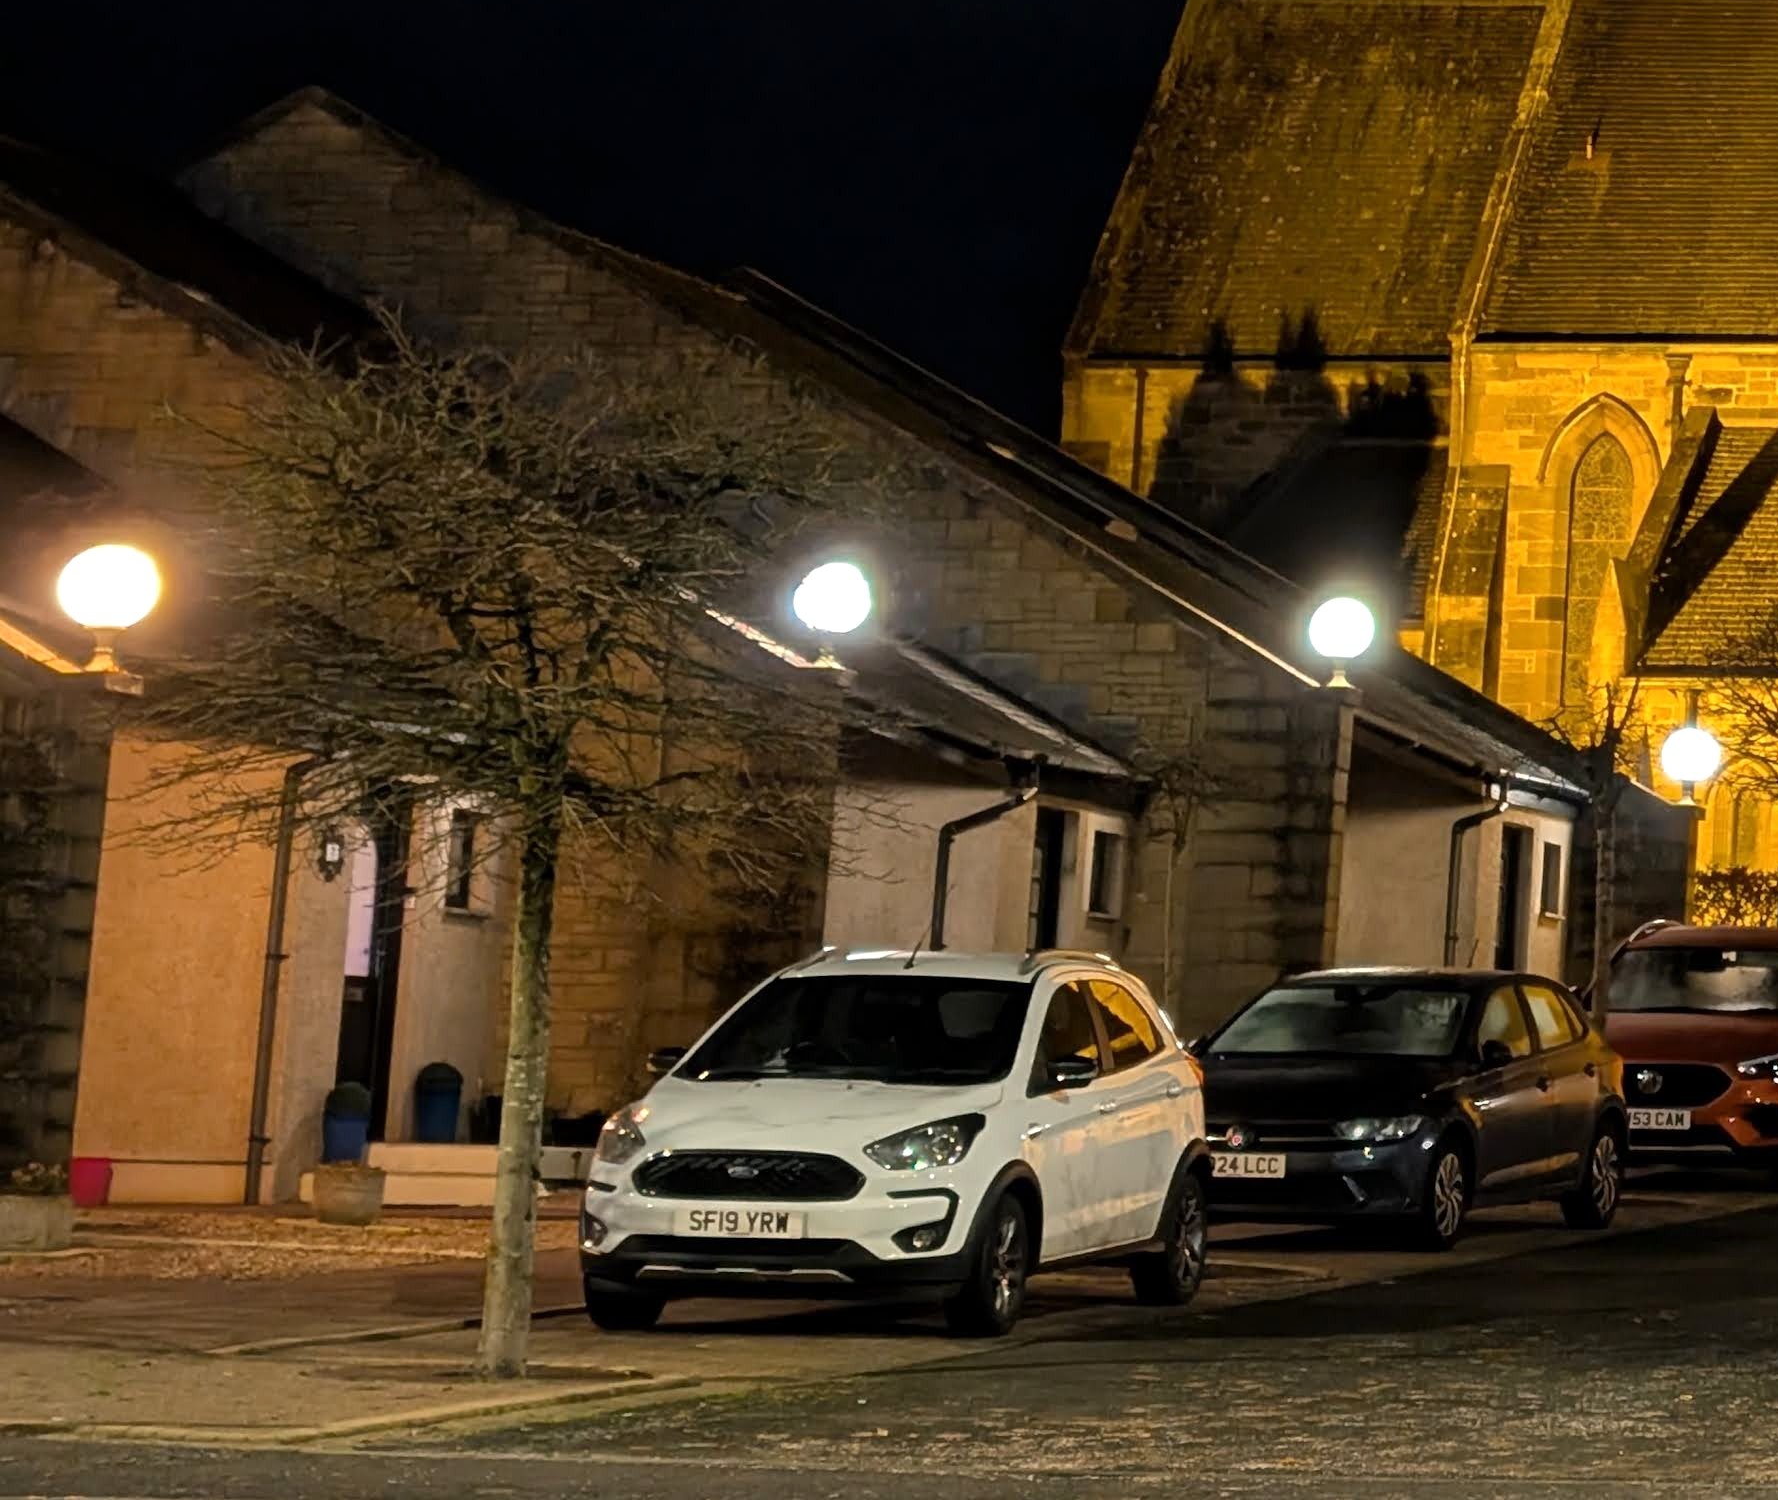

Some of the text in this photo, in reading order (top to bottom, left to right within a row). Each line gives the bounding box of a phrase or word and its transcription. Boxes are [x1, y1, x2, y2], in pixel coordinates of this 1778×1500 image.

[1655, 1112, 1684, 1126] CAM
[1244, 1156, 1278, 1174] LCC
[689, 1210, 789, 1233] SF19 YRW
